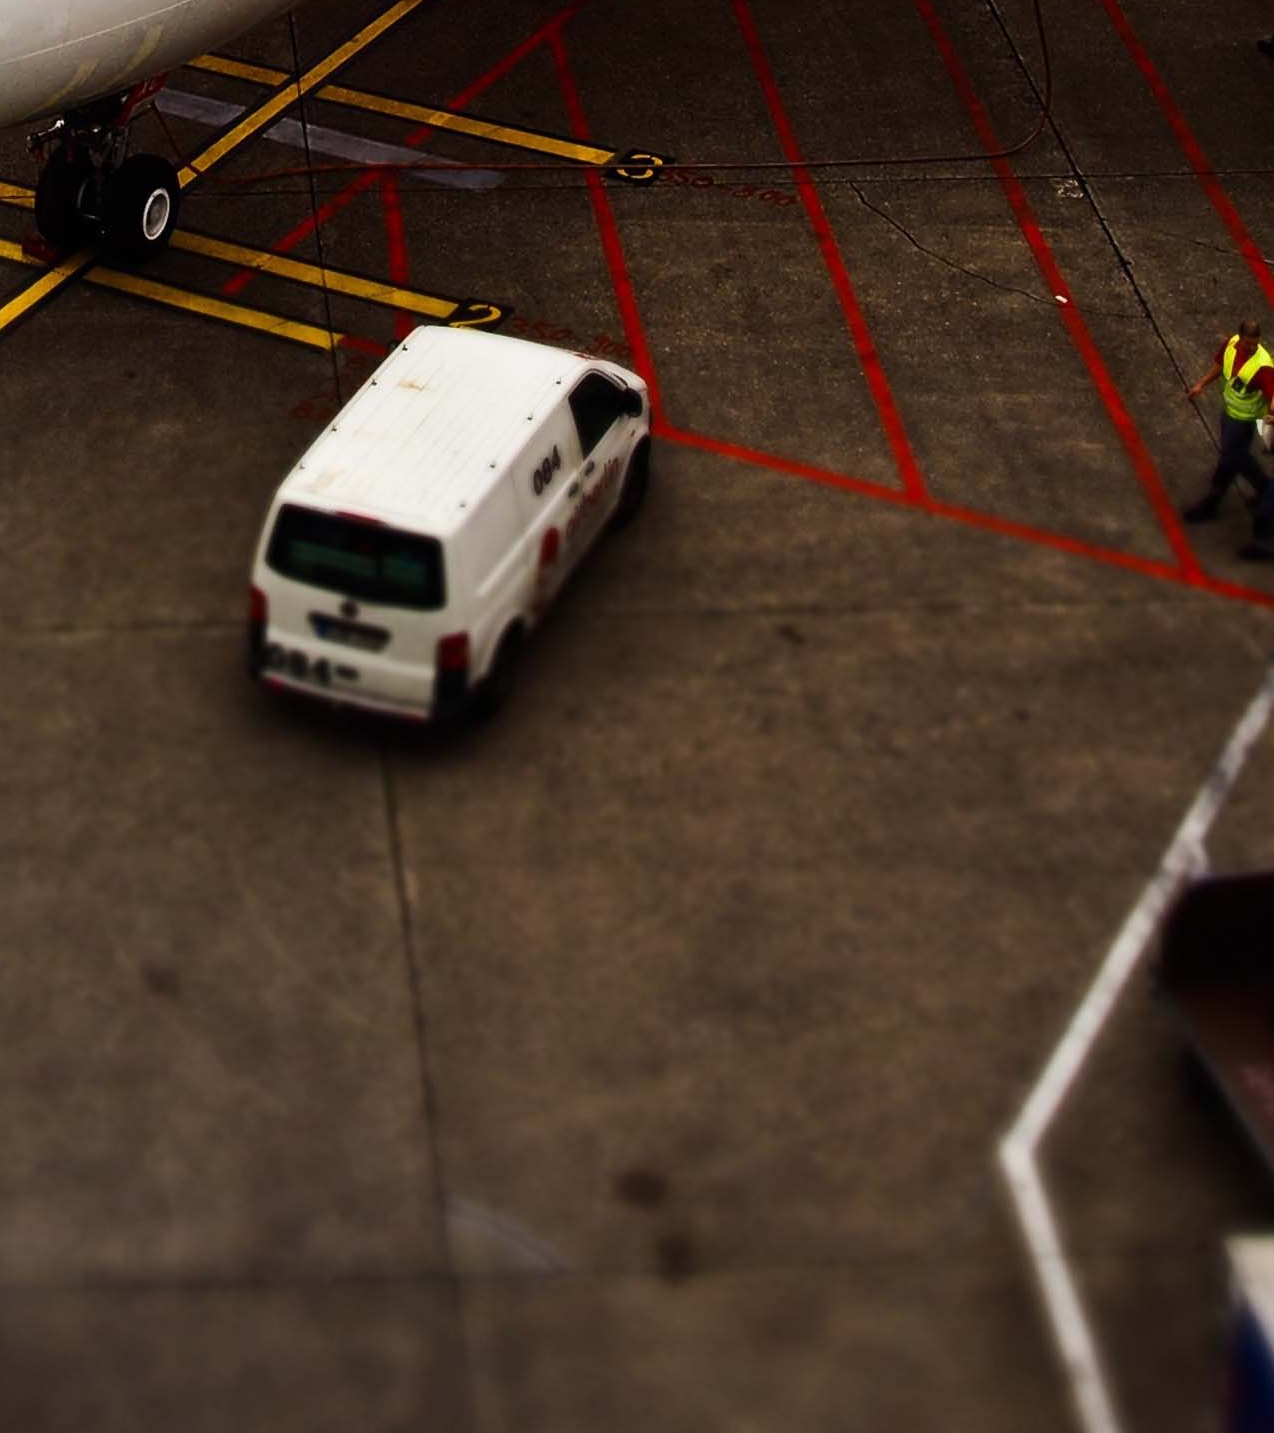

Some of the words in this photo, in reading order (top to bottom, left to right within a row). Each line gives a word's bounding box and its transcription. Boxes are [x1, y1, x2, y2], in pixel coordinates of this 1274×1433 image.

[617, 154, 663, 179] 3
[448, 304, 502, 329] 2
[533, 444, 562, 497] 084
